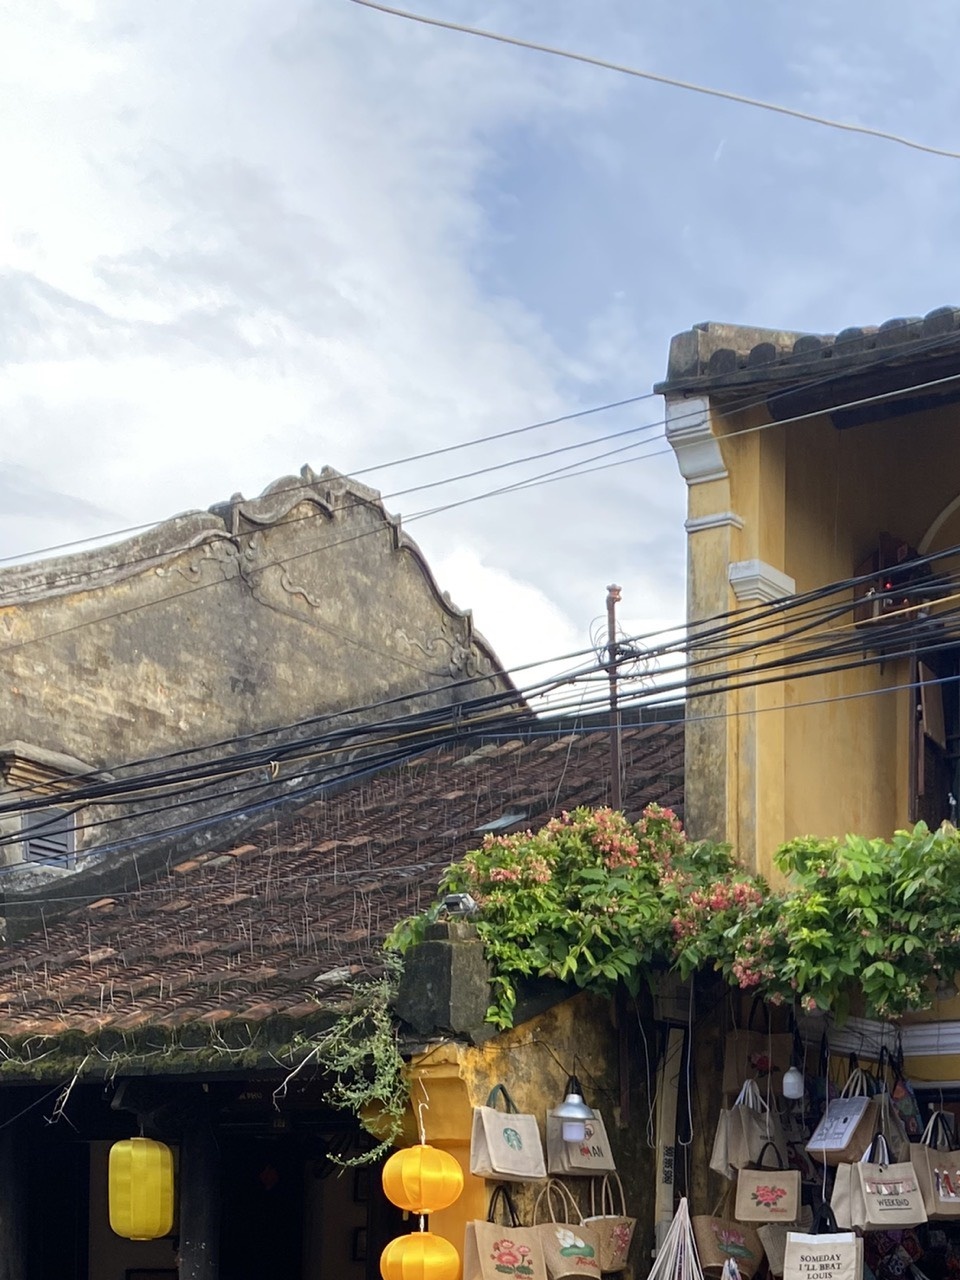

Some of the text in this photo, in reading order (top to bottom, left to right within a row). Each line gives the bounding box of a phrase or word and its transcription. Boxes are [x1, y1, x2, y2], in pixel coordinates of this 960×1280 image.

[876, 1198, 910, 1207] WEEKEND
[800, 1254, 842, 1262] SOMEDAY
[819, 1263, 842, 1271] BEAT
[807, 1272, 833, 1280] LOUIS
